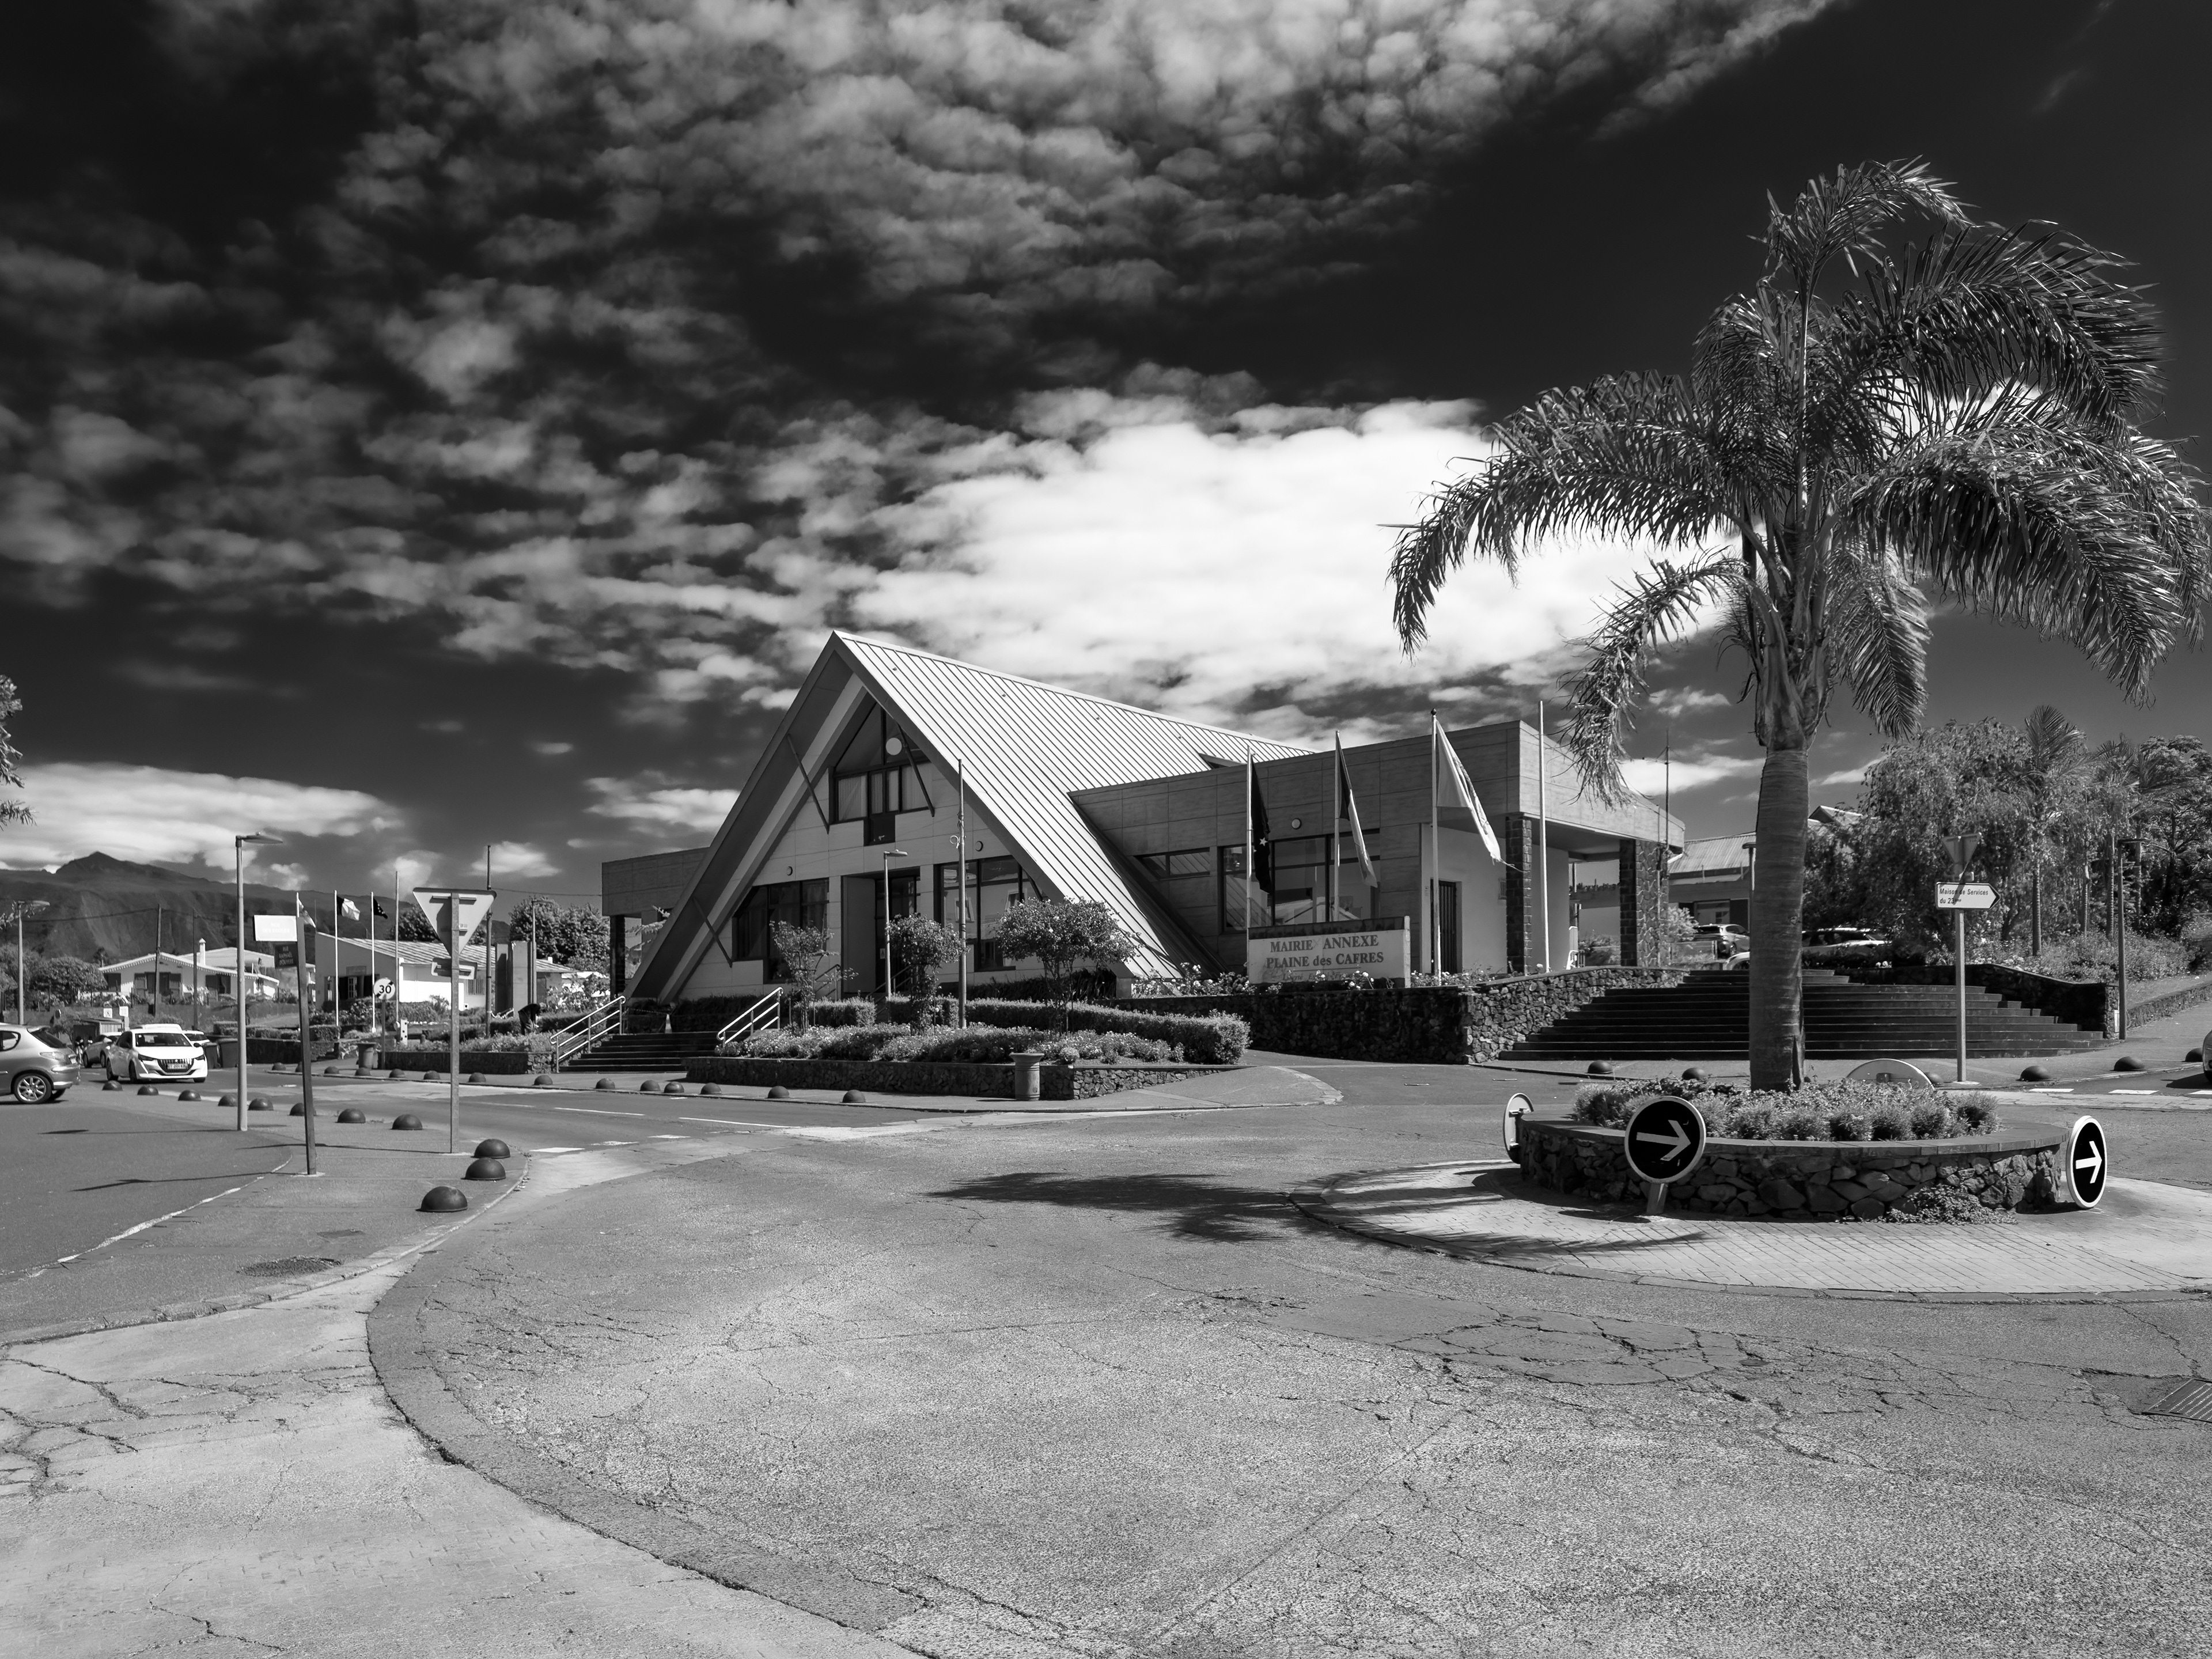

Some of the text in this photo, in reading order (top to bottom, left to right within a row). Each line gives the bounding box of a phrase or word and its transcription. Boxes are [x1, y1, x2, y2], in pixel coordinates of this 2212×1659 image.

[1270, 934, 1379, 953] MAIRIE ANNEXE
[1266, 951, 1384, 969] PLAINE des CAFRES
[379, 985, 391, 994] 30
